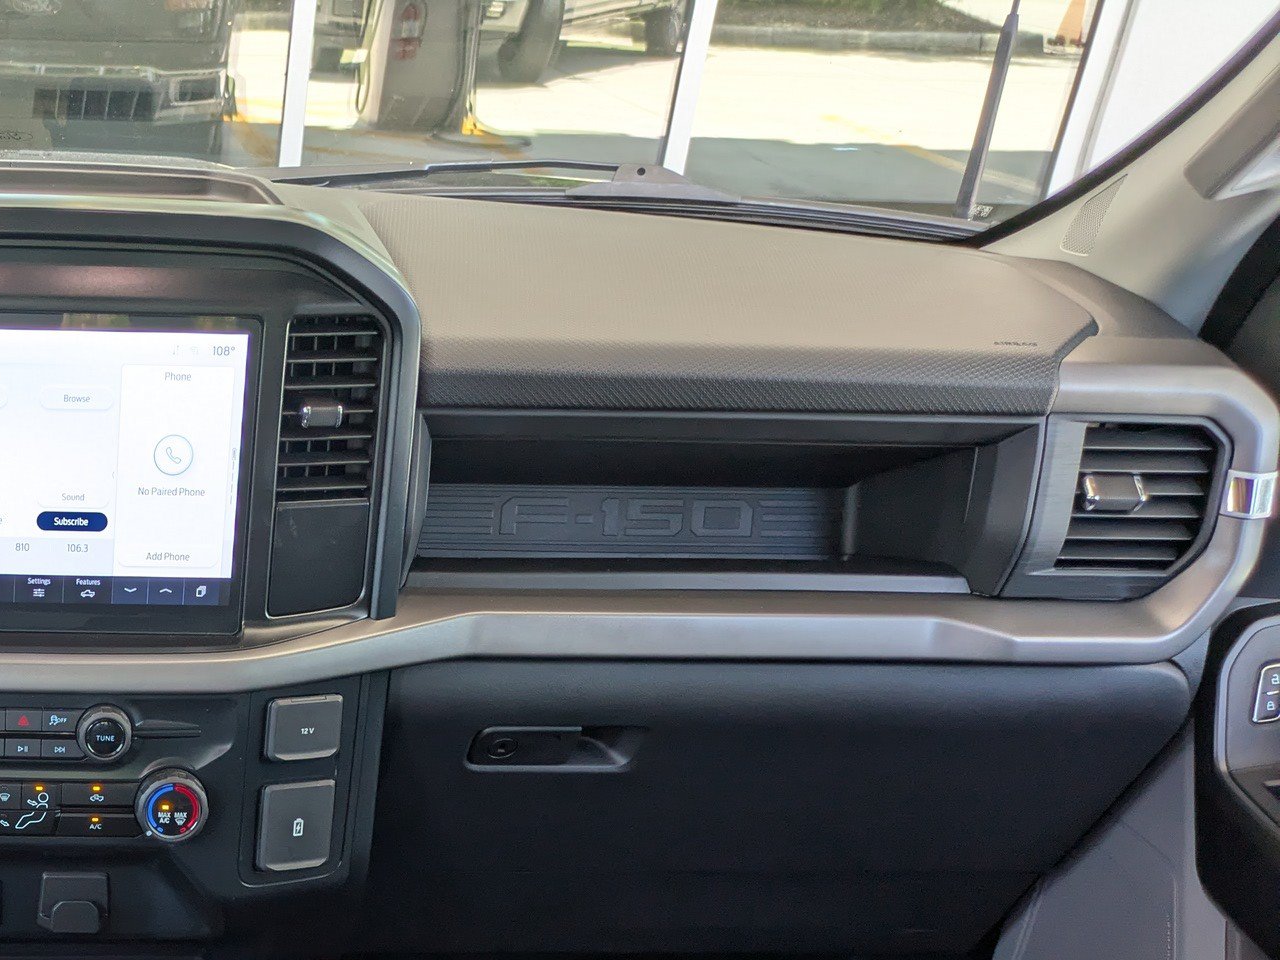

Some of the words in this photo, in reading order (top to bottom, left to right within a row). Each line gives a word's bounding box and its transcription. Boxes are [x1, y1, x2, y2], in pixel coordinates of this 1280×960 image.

[212, 346, 235, 356] 108°
[164, 372, 192, 381] Phone
[63, 394, 90, 403] Browse
[61, 492, 85, 501] Sound
[137, 487, 151, 496] No
[152, 487, 177, 496] Paired
[179, 488, 205, 497] Phone
[53, 517, 89, 526] Subscribe
[498, 496, 754, 538] F-150
[15, 543, 30, 551] 810
[67, 543, 88, 553] 106.3
[146, 552, 162, 561] Add
[164, 552, 190, 561] Phone
[27, 578, 51, 586] Settings
